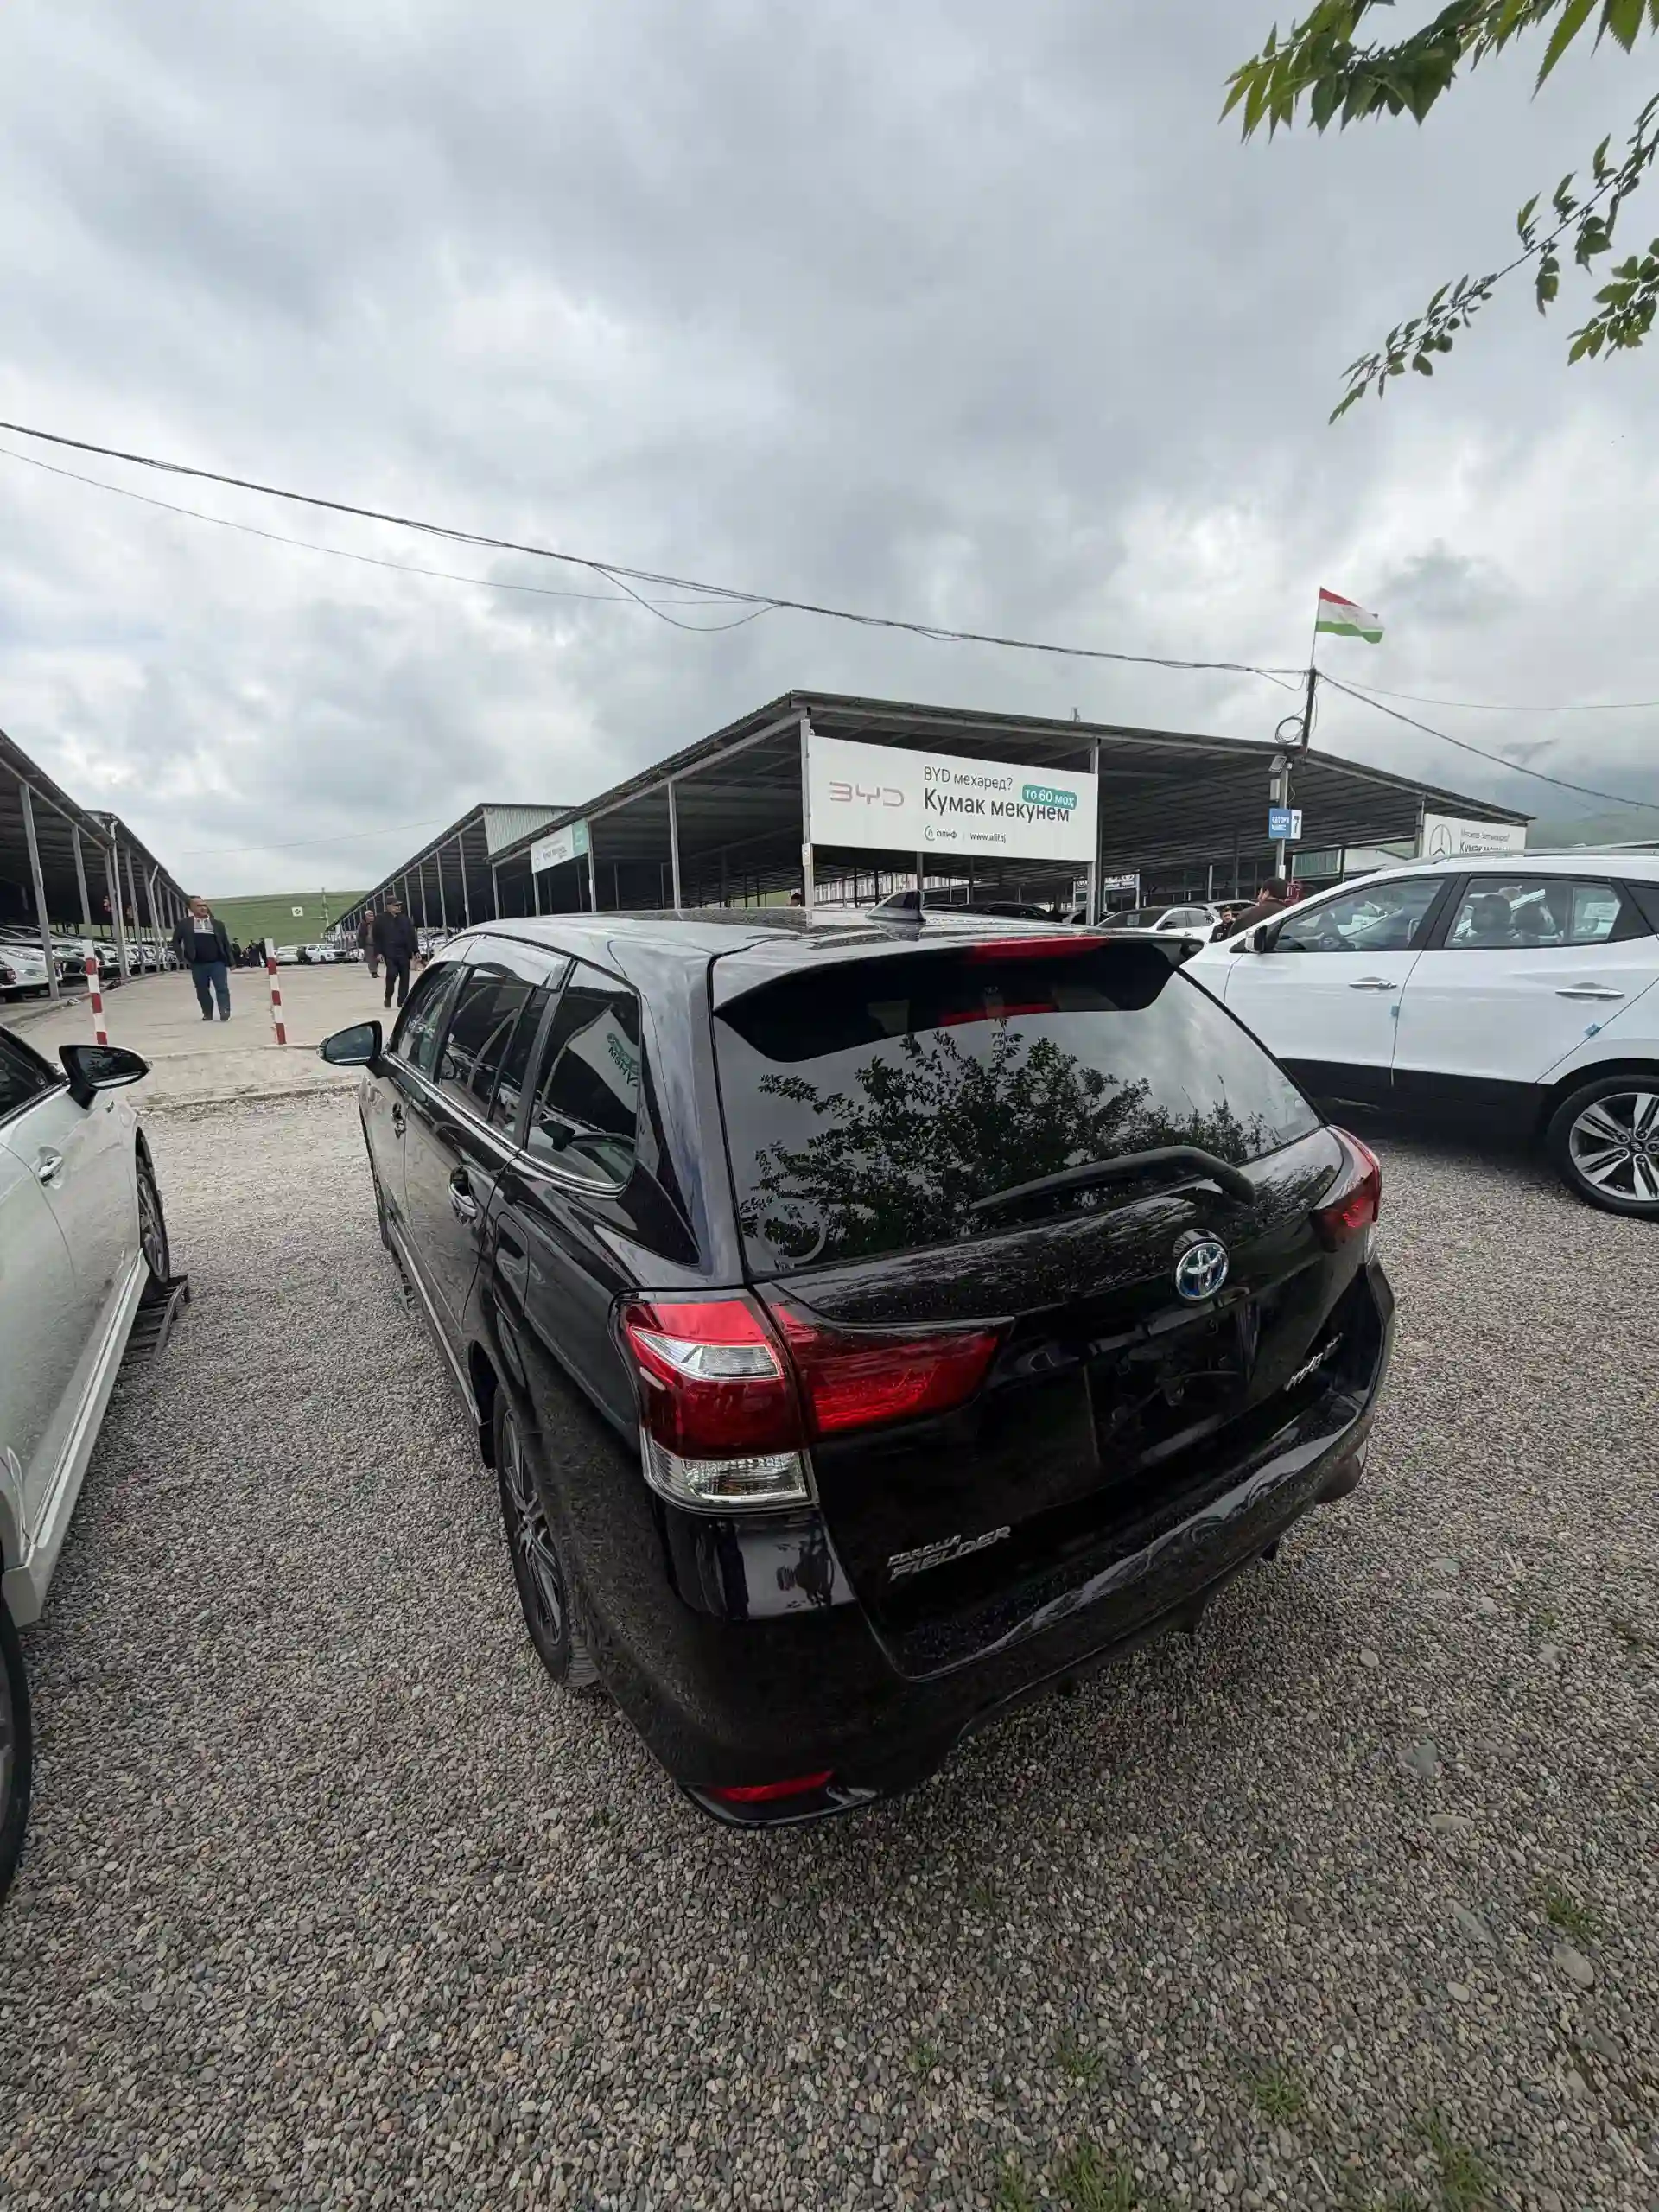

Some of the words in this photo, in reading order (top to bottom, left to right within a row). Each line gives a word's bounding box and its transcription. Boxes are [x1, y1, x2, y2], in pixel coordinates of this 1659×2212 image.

[924, 766, 950, 783] BYD
[954, 774, 1013, 792] мехаред?
[924, 787, 985, 816] Кумак
[990, 798, 1069, 823] мекунем
[1025, 790, 1037, 801] то
[1039, 788, 1052, 803] 60
[888, 1526, 1011, 1583] FIELDER
